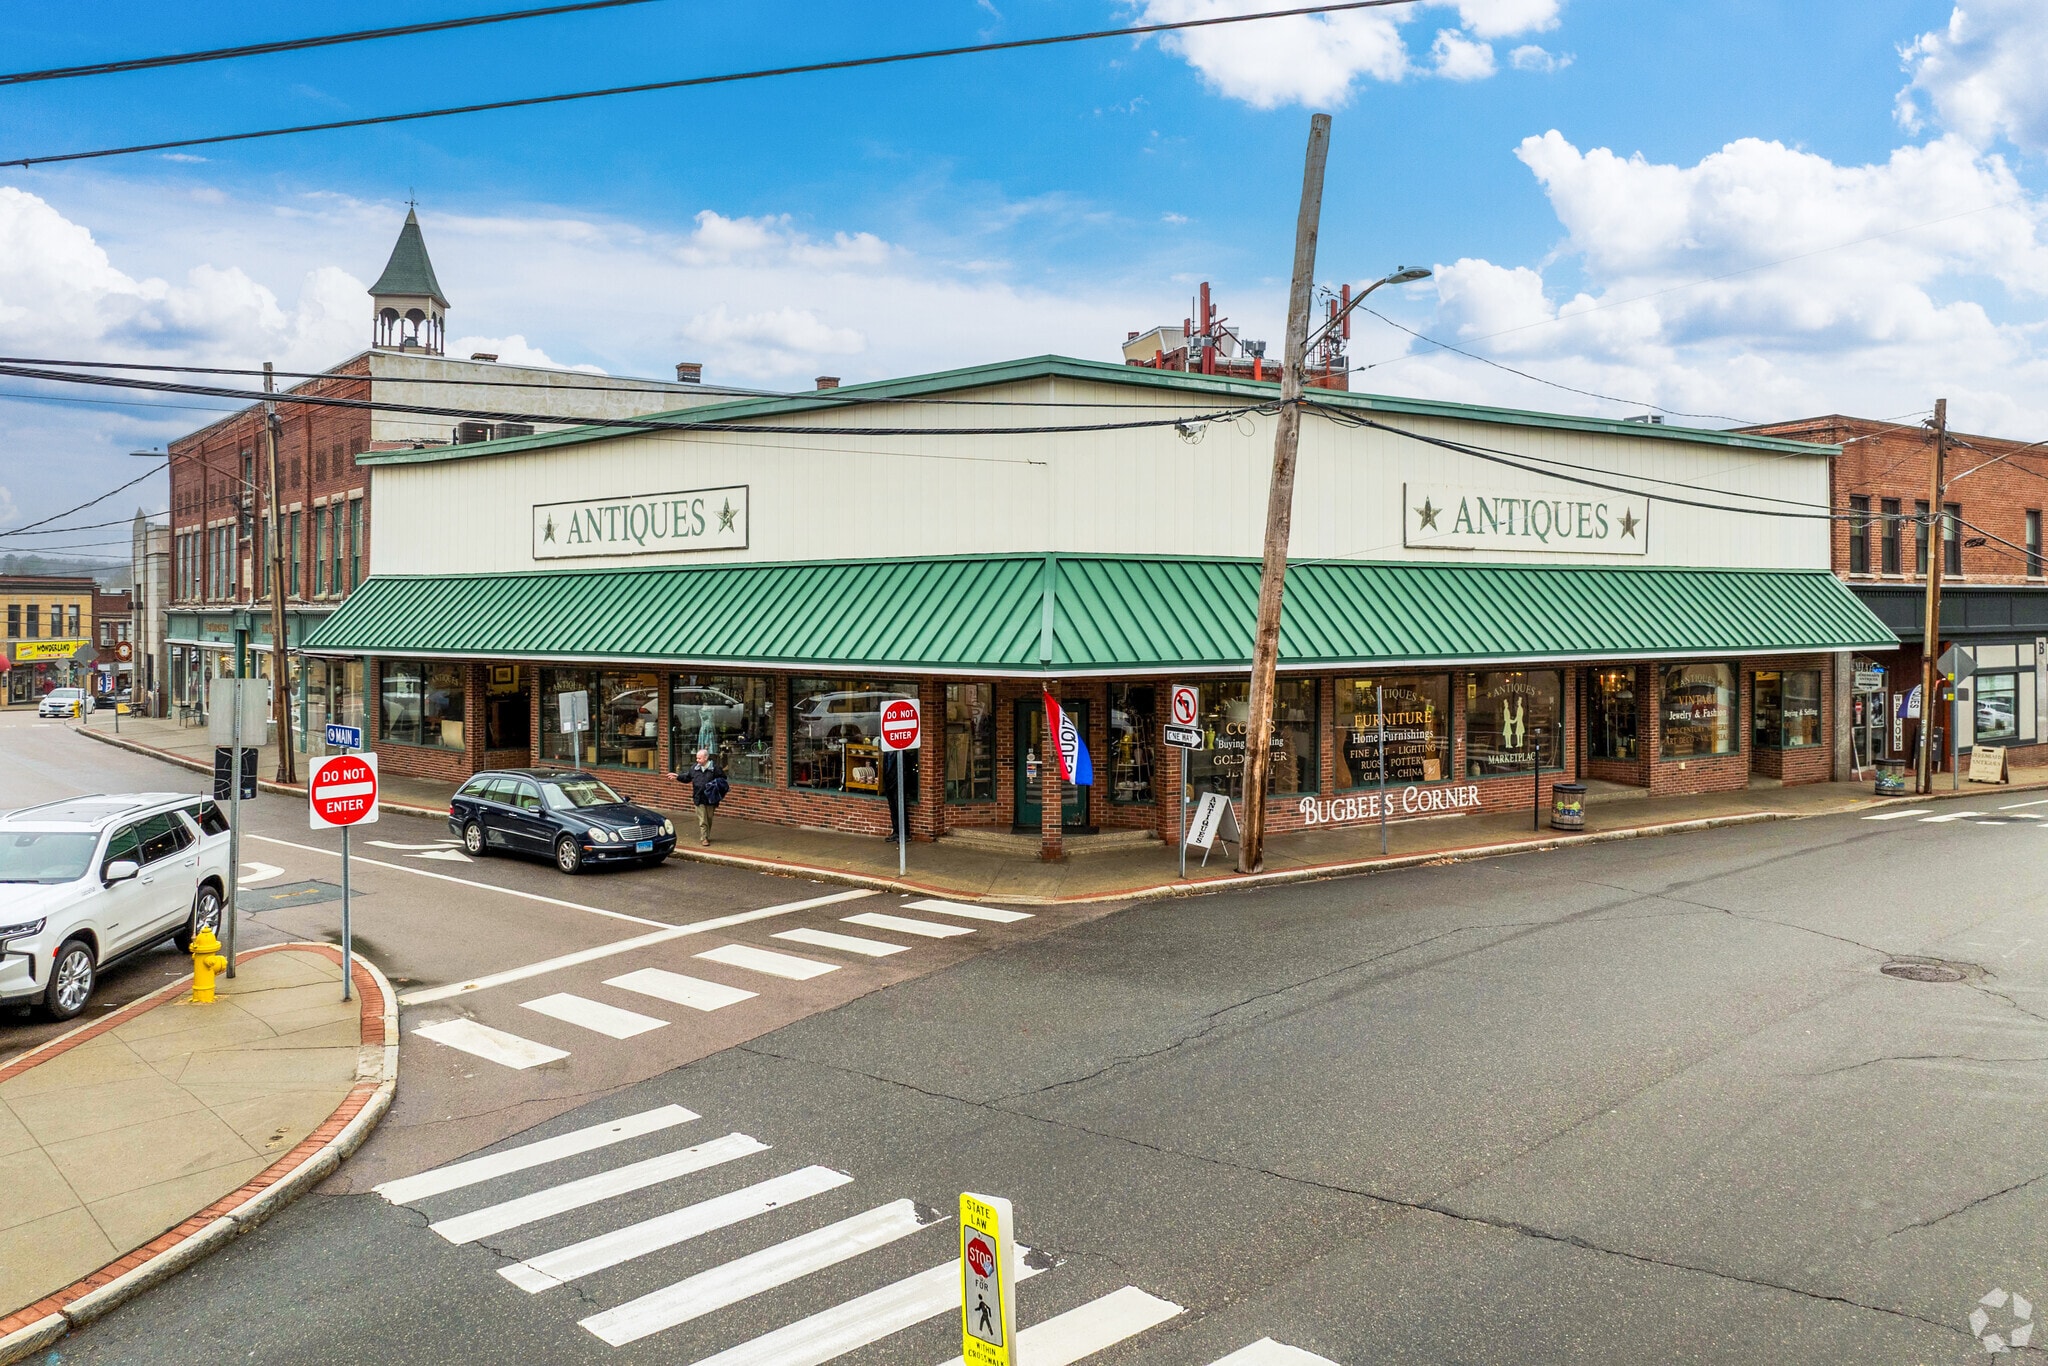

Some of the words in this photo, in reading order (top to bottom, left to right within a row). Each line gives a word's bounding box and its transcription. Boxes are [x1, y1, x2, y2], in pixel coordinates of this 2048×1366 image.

[566, 498, 706, 547] ANTIQUES
[1451, 496, 1609, 544] ANTIQUES
[36, 643, 71, 653] WONDERLAND
[1493, 683, 1536, 698] ANTIQUES
[1678, 693, 1717, 706] VINTAGE
[887, 711, 896, 719] DO
[900, 710, 914, 718] NOT
[1354, 710, 1433, 727] FURNITURE
[1694, 709, 1700, 719] &
[1226, 720, 1276, 736] COS
[335, 727, 353, 745] MAIN
[890, 731, 912, 741] ENTER
[1181, 732, 1194, 743] WAY
[1352, 732, 1378, 744] Home
[1383, 729, 1434, 742] Furnishings
[1218, 738, 1245, 750] Buying
[1350, 749, 1370, 759] FINE
[1398, 744, 1436, 755] LIGHTING
[1213, 754, 1244, 766] GOLD
[1361, 760, 1381, 770] RUGS
[1390, 756, 1425, 767] POTTERY
[1487, 751, 1537, 765] MARKETPLAC
[322, 771, 339, 783] DO
[343, 767, 366, 781] NOT
[1363, 771, 1389, 781] GLAS
[1397, 768, 1423, 778] CHINA
[326, 798, 364, 813] ENTER
[1300, 792, 1394, 825] BUGBEE'S
[1402, 785, 1481, 813] CORNER
[1196, 796, 1216, 843] ANTIQUES
[966, 1199, 991, 1220] STATE
[970, 1214, 988, 1230] LAW
[969, 1246, 992, 1266] STOP
[975, 1279, 989, 1292] FOR
[976, 1342, 996, 1356] WITHIN
[968, 1349, 1004, 1366] CROSSWALK
